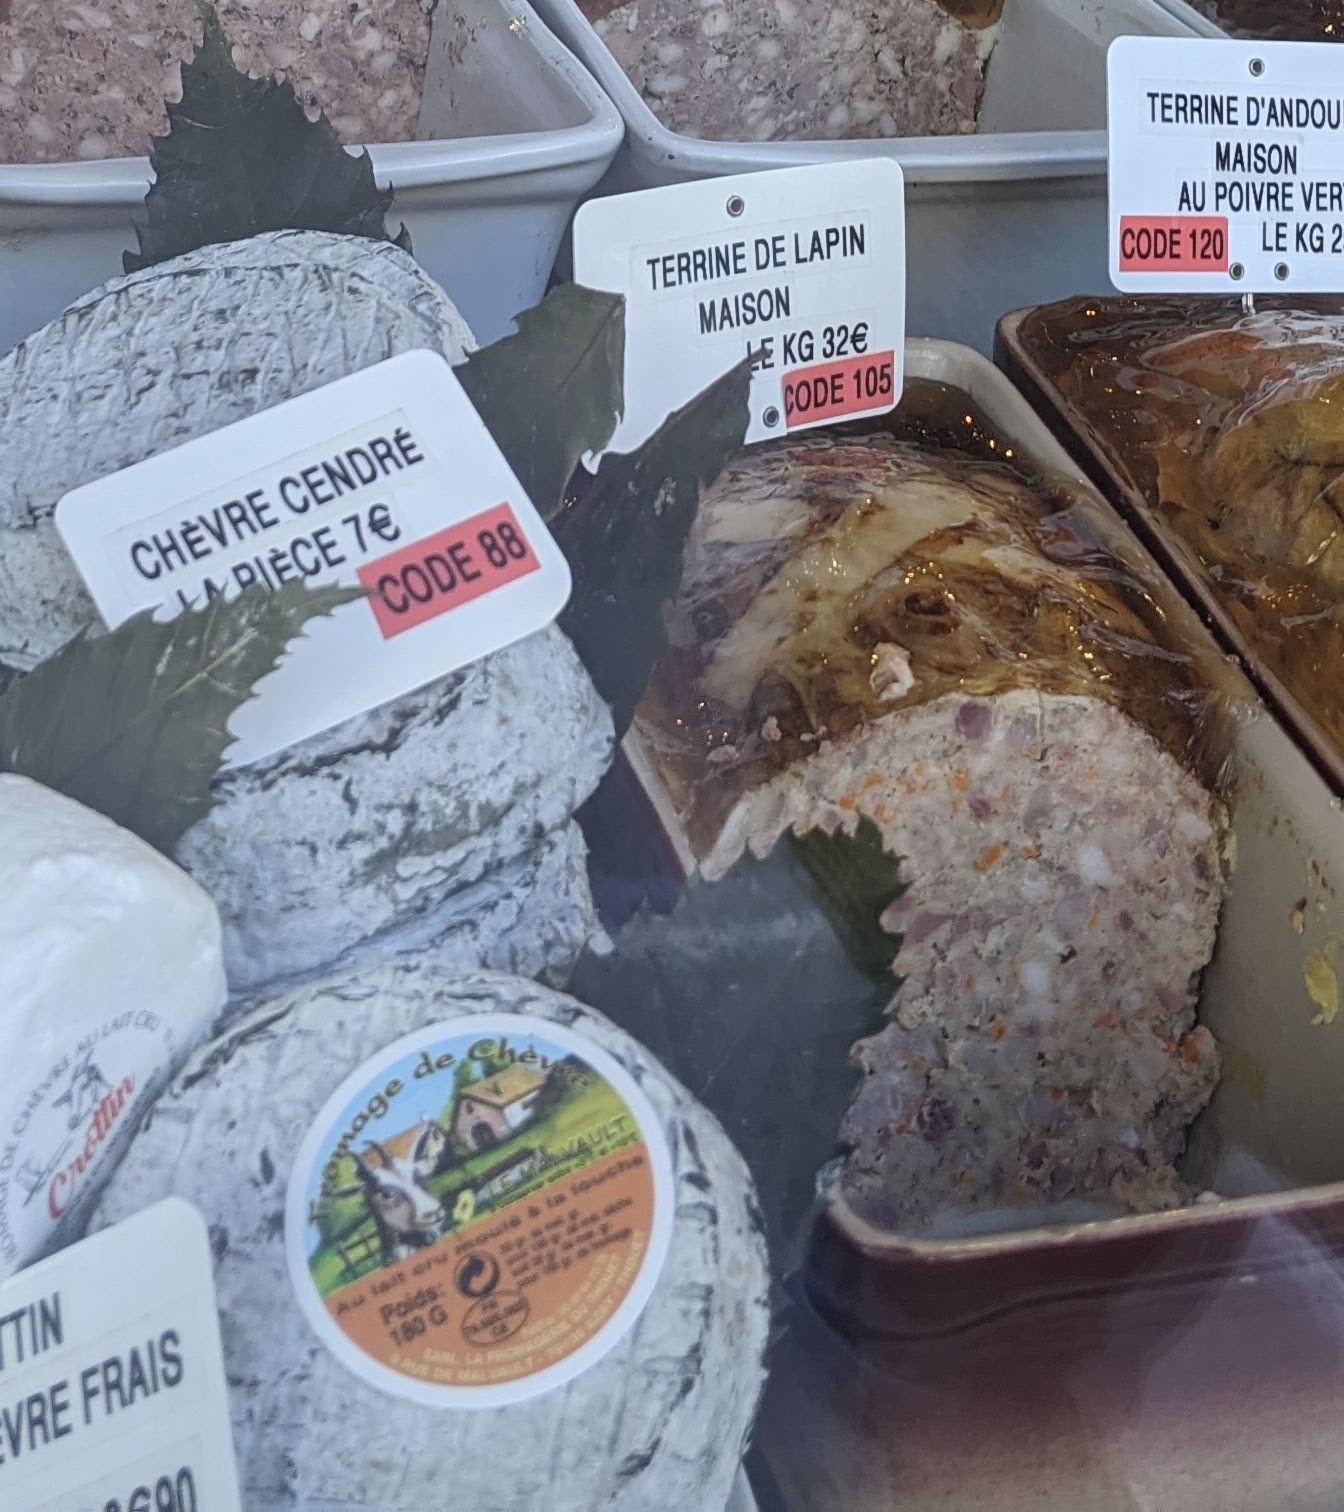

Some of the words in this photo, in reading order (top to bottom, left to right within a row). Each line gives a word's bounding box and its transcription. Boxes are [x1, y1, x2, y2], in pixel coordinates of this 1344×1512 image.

[1147, 91, 1239, 126] TERRINE
[1215, 140, 1298, 176] MAISON
[1177, 180, 1206, 212] AU
[1214, 180, 1294, 213] POIVRE
[646, 241, 747, 291] TERRINE
[754, 235, 787, 272] DE
[794, 223, 867, 265] LAPIN
[1120, 227, 1182, 261] CODE
[1188, 228, 1225, 261] 120
[1262, 221, 1288, 253] LE
[1295, 222, 1325, 254] KG
[698, 285, 791, 335] MAISON
[746, 337, 775, 372] LE
[783, 329, 814, 366] KG
[821, 321, 869, 360] 32€
[783, 372, 845, 417] CODE
[852, 362, 892, 400] 105
[130, 488, 280, 581] CHÈVRE
[278, 427, 425, 515] CENDRÉ
[341, 502, 402, 554] 7€
[376, 541, 482, 615] CODE
[477, 521, 528, 568] 88
[413, 1050, 457, 1080] de
[80, 1328, 185, 1426] FRAIS
